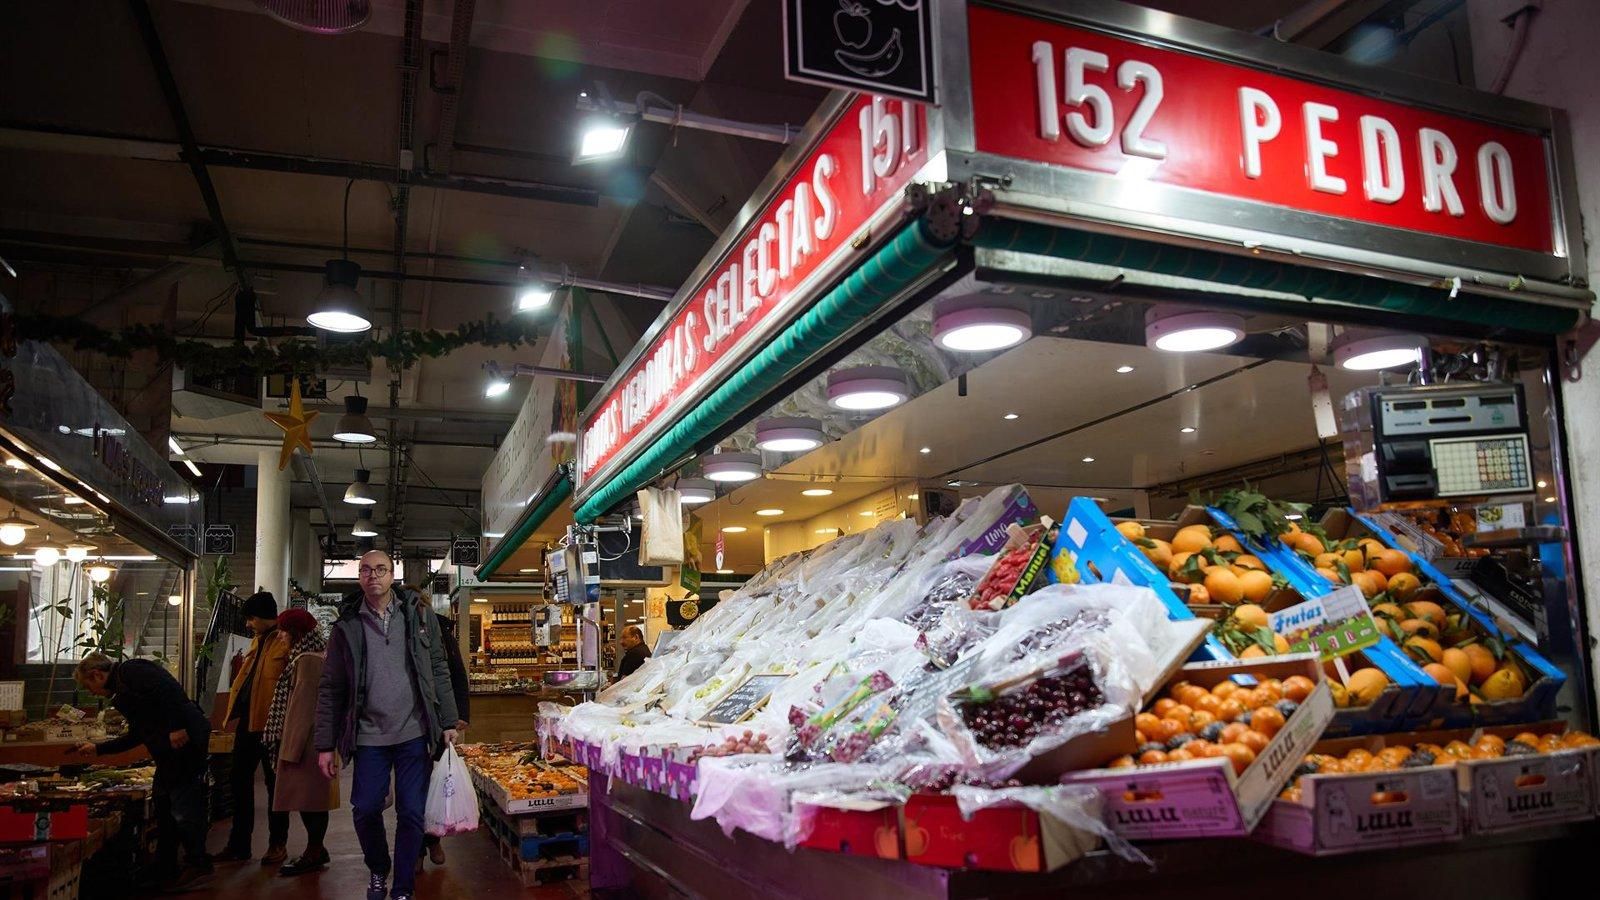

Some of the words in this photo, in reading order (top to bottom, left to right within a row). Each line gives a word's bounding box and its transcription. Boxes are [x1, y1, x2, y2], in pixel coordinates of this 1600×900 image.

[1032, 40, 1167, 160] 152
[1238, 86, 1518, 225] PEDRO
[703, 153, 838, 352] SELECTAS
[859, 96, 919, 196] 151
[1015, 543, 1050, 595] Manuel
[1274, 606, 1322, 633] Frutas
[1263, 730, 1295, 779] LULU
[528, 799, 555, 807] LULU
[1115, 807, 1181, 824] LULU
[1507, 791, 1555, 813] LULU
[1356, 811, 1413, 832] LULU
